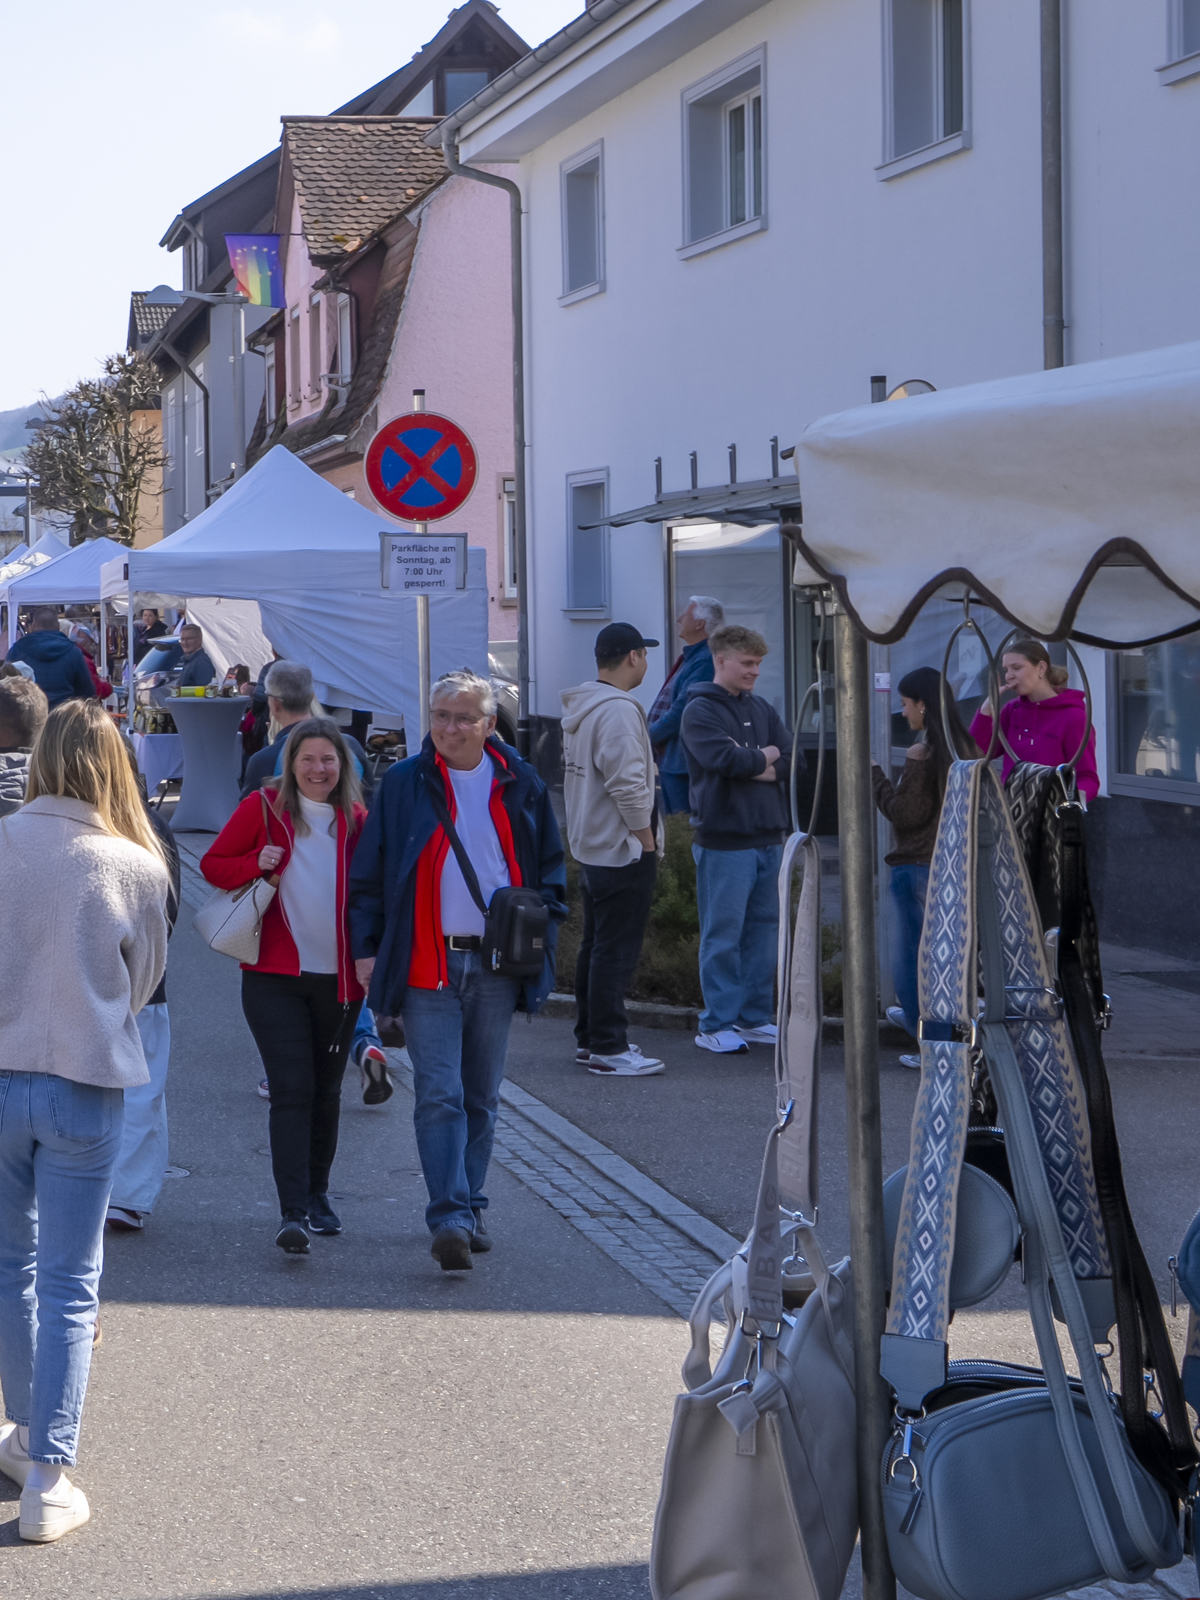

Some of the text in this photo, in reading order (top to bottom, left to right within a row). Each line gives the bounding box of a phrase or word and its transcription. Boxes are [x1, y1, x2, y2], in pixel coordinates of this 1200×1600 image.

[391, 544, 439, 552] Parkfläche
[396, 556, 451, 565] Sonntag, ab
[404, 567, 443, 575] 7:00 Uhr
[404, 580, 446, 588] gesperrt!
[753, 1183, 779, 1279] BAG
